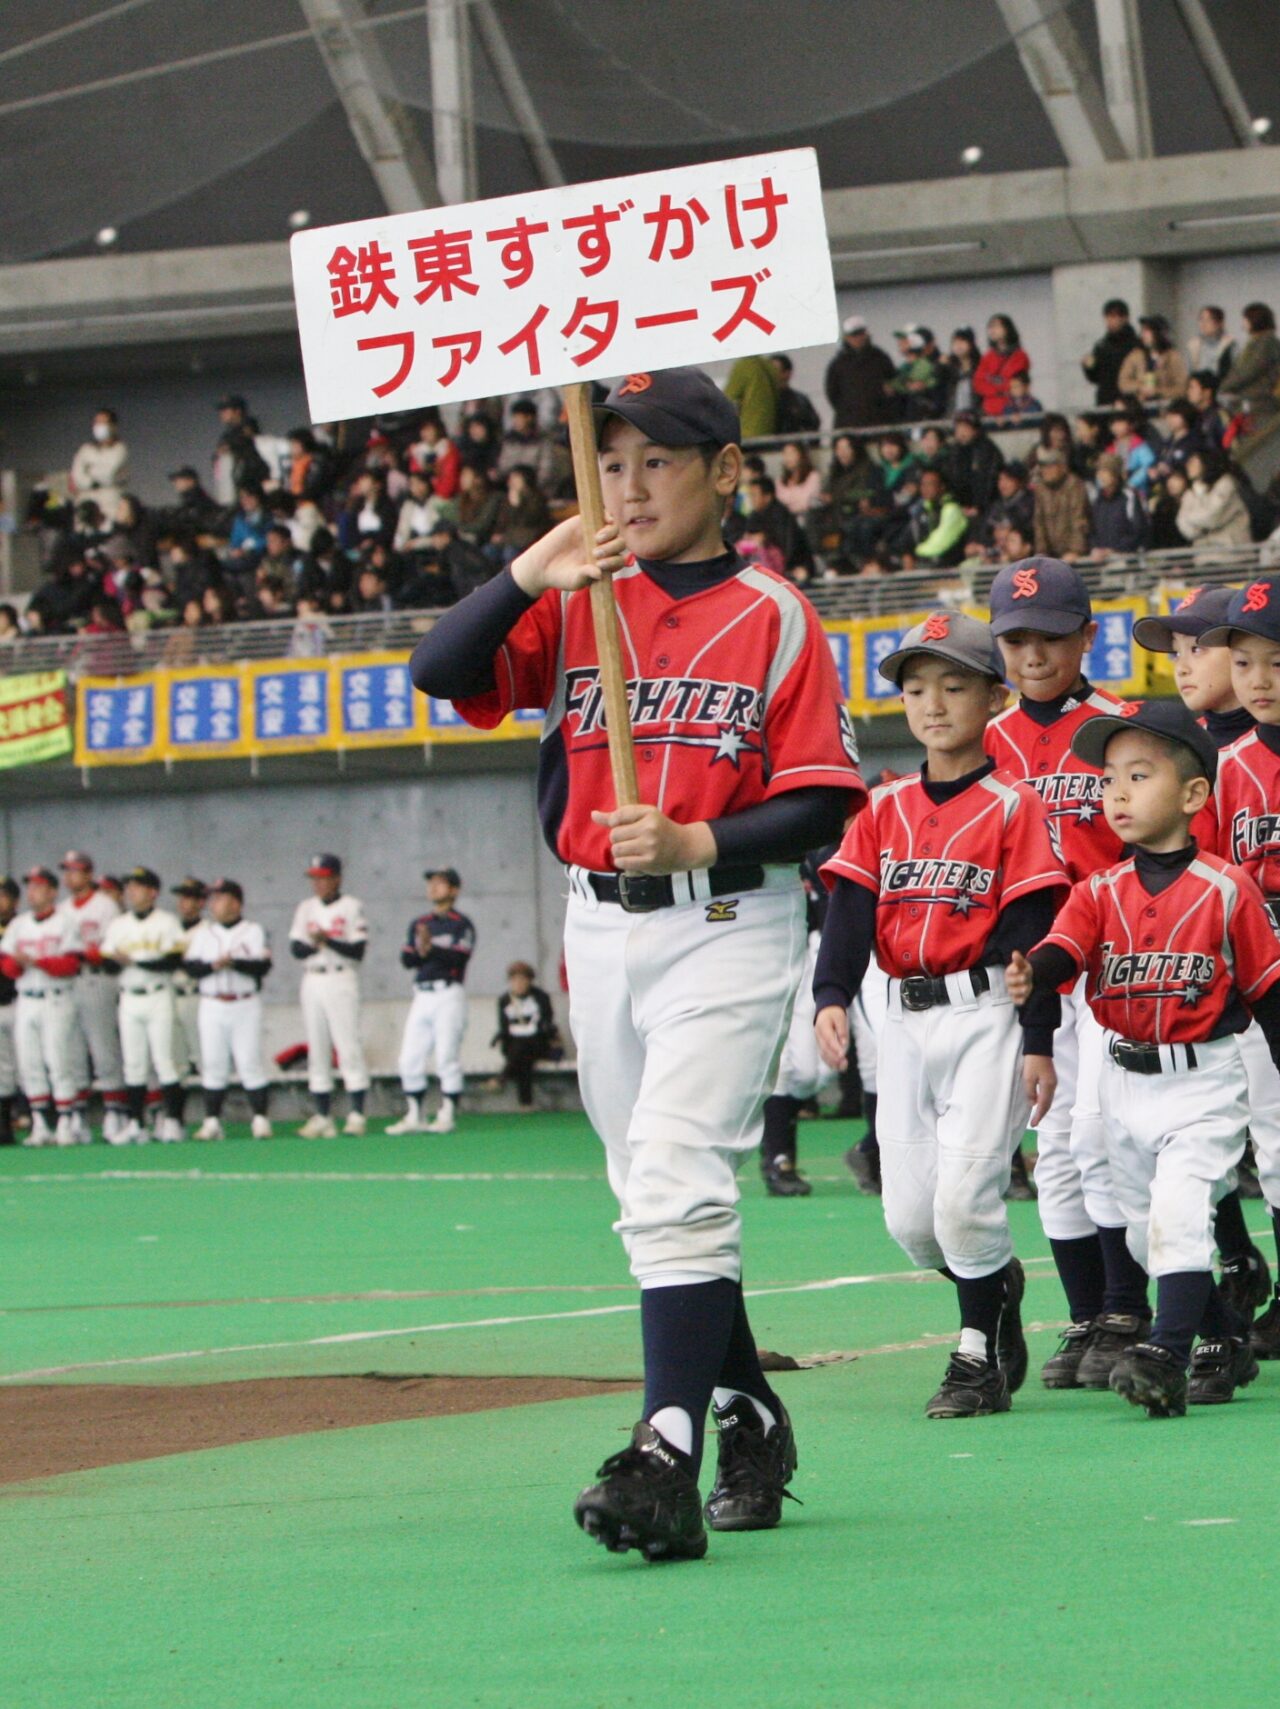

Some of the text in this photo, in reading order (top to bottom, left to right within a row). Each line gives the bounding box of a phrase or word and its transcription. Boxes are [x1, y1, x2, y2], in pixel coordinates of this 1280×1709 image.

[327, 177, 789, 319] 鉄東すずかけ
[357, 267, 777, 398] ファイターズ
[1011, 568, 1040, 599] S
[1242, 582, 1272, 613] S
[921, 615, 950, 642] S
